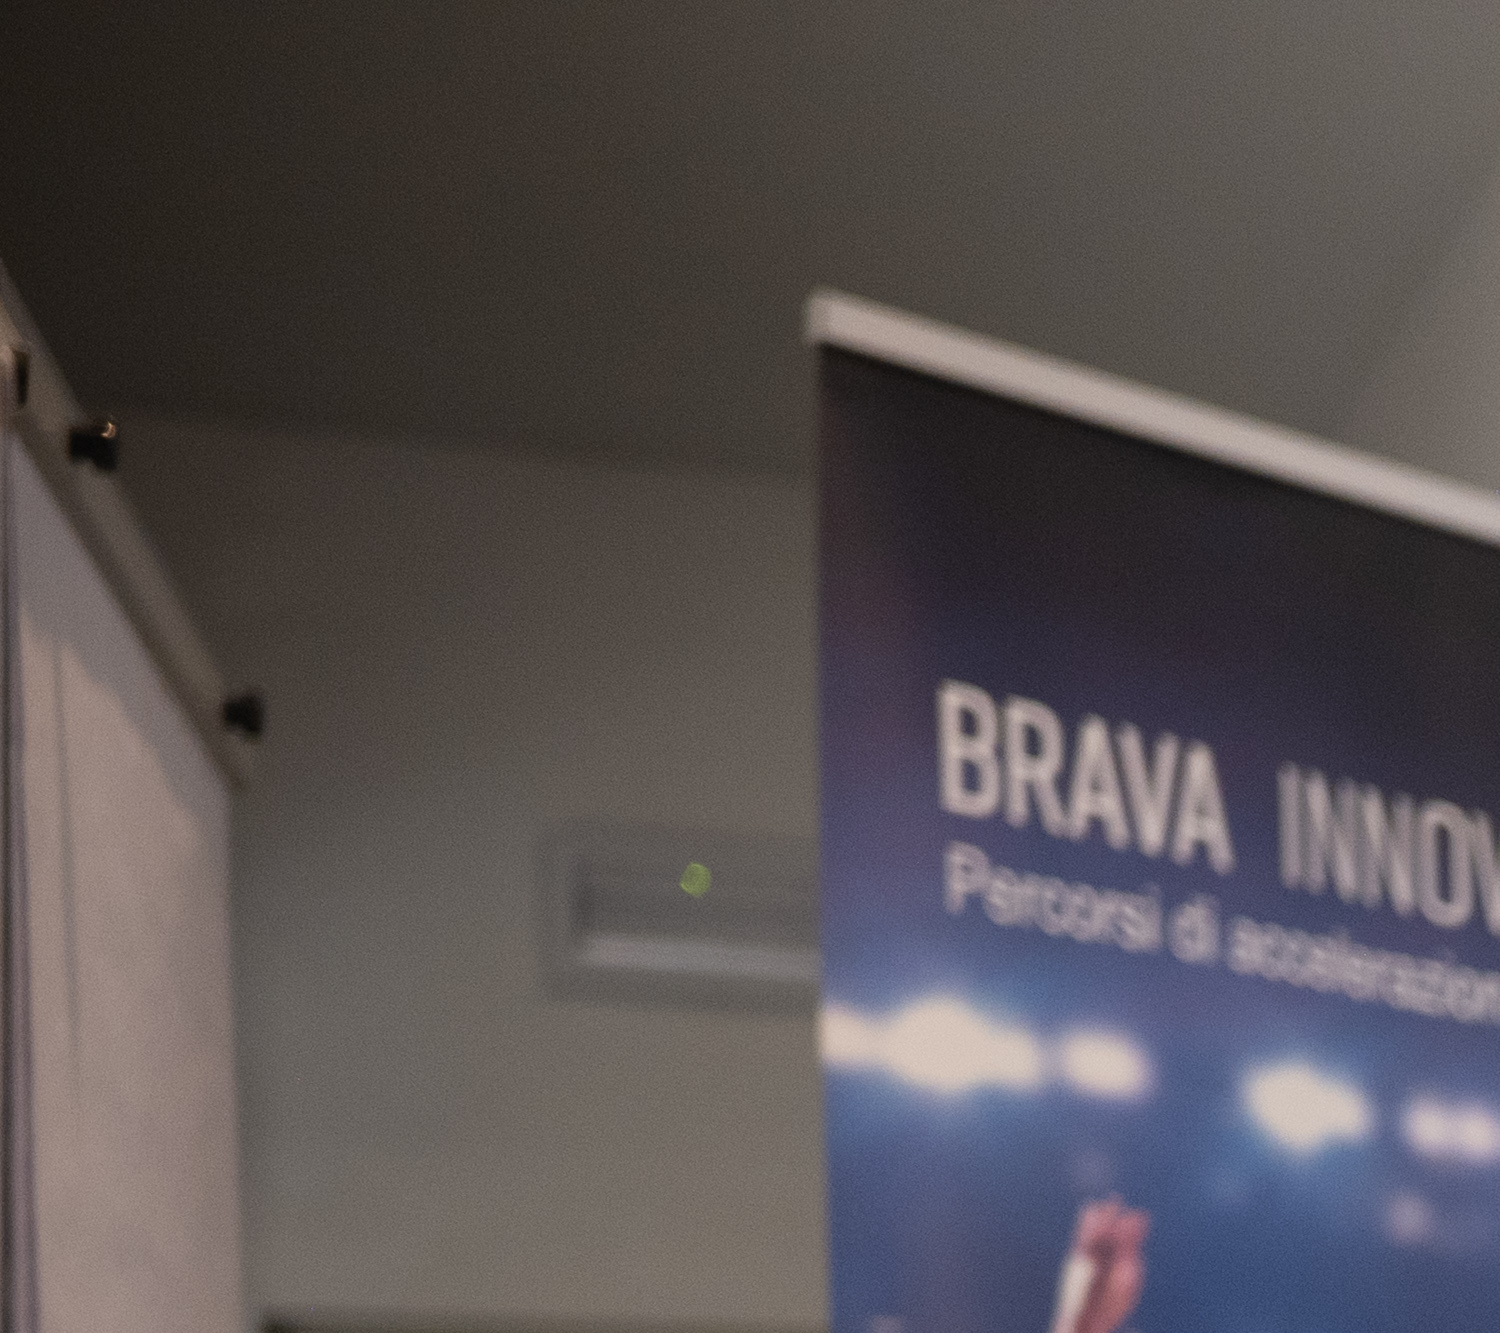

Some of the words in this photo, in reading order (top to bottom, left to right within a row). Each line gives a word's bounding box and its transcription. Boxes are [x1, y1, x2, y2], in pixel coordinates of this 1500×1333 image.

[937, 679, 1236, 875] BRAVA
[943, 839, 1163, 955] Percorsi
[1167, 891, 1222, 966] di
